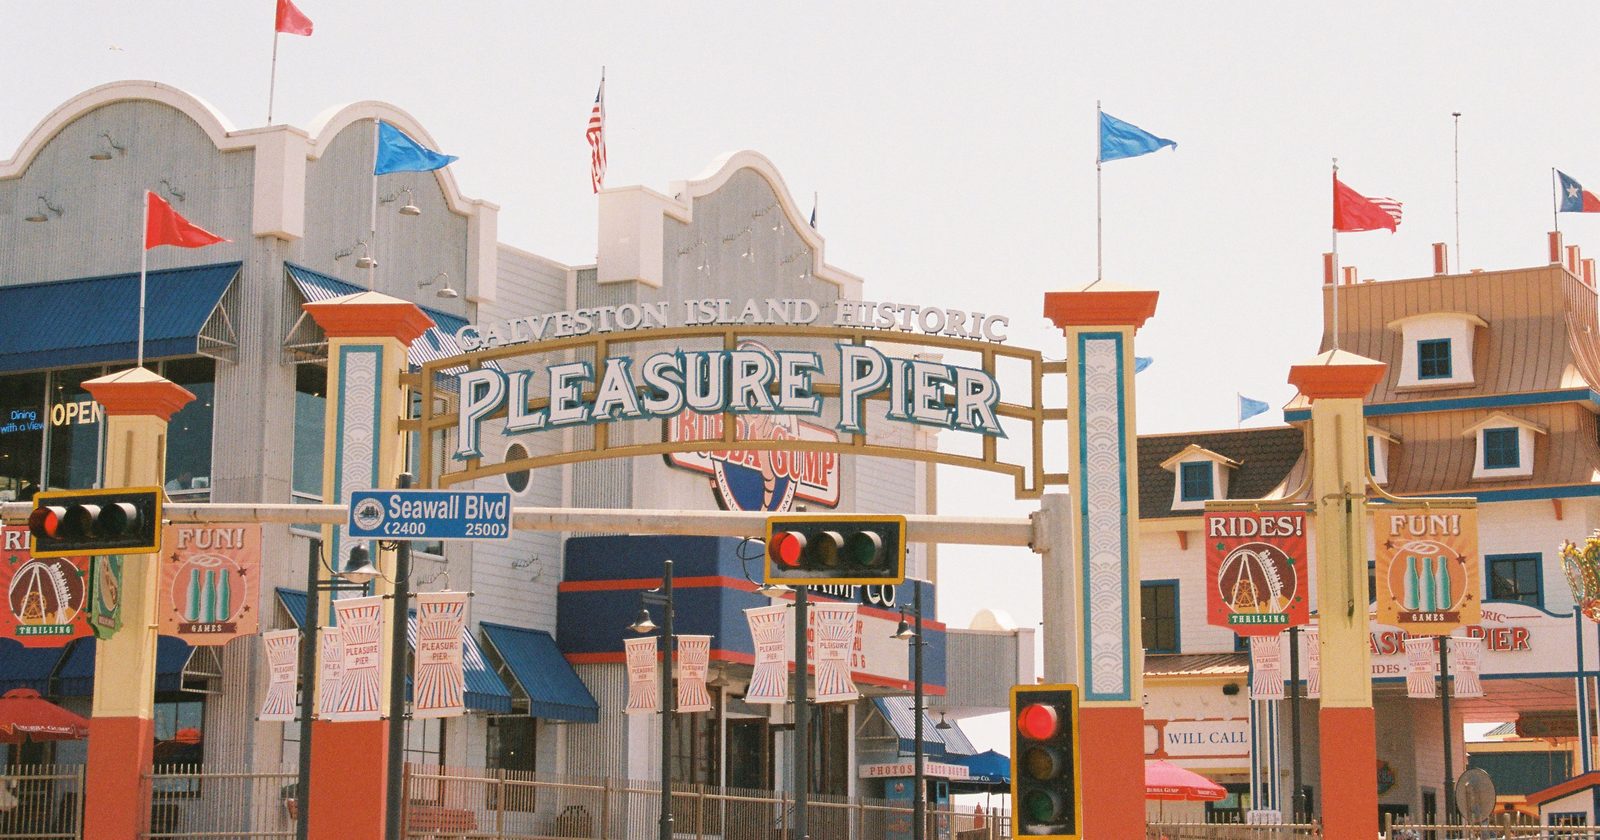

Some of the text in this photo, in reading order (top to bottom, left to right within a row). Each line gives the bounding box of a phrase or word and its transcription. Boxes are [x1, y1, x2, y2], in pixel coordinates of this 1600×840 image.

[455, 298, 1009, 351] GALVESTON ISLAND HISTORIC
[453, 342, 1009, 462] PLEASURE PIER
[11, 410, 36, 421] Dining
[52, 400, 100, 427] OPEN
[0, 424, 17, 434] with
[389, 494, 459, 520] Seawall
[465, 495, 507, 520] Blvd
[392, 522, 499, 536] 2400 2500
[1209, 515, 1303, 538] RIDES!
[1390, 513, 1461, 537] FUN!
[177, 528, 245, 551] FUN!
[1231, 614, 1286, 624] THRILLING
[1412, 613, 1445, 622] GAMES
[19, 625, 71, 635] THRILLING
[191, 624, 223, 633] GAMES
[346, 645, 378, 656] PLEASURE
[422, 641, 458, 651] PLEASURE
[355, 657, 369, 666] PIER
[432, 653, 448, 661] PIER
[1372, 664, 1400, 674] IDES
[1168, 731, 1247, 744] WILL CALL
[869, 764, 913, 776] PHOTOS
